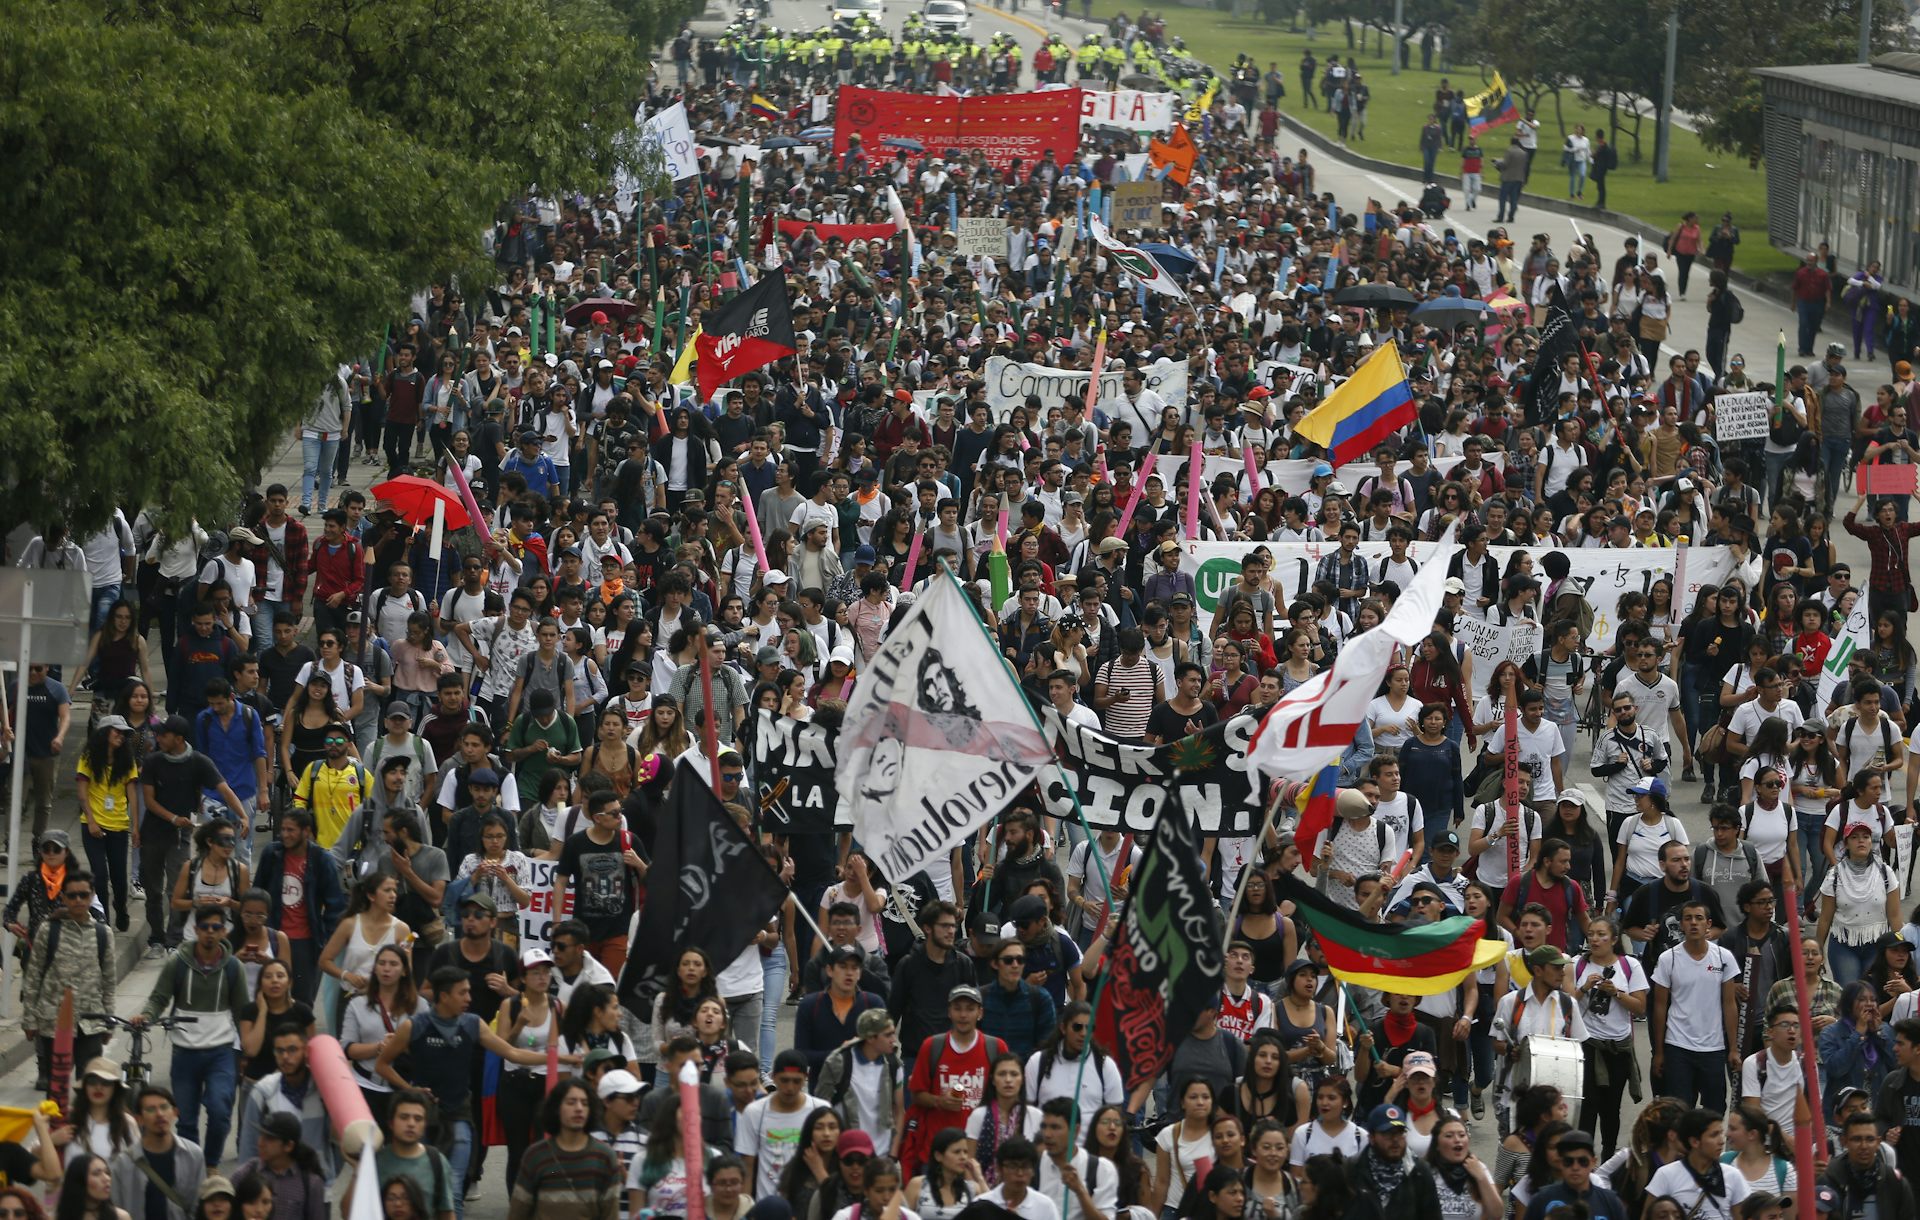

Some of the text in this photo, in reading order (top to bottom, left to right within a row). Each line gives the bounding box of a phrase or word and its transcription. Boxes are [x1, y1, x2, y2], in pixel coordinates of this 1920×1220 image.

[929, 135, 1036, 145] UNIVERSIDADES
[1472, 634, 1489, 646] HAY
[1485, 628, 1499, 640] NO
[1466, 643, 1499, 660] ASES?
[1507, 734, 1518, 779] SOCIAL
[791, 784, 824, 809] LA
[1508, 790, 1518, 806] ES
[940, 1071, 984, 1089] LEÓN
